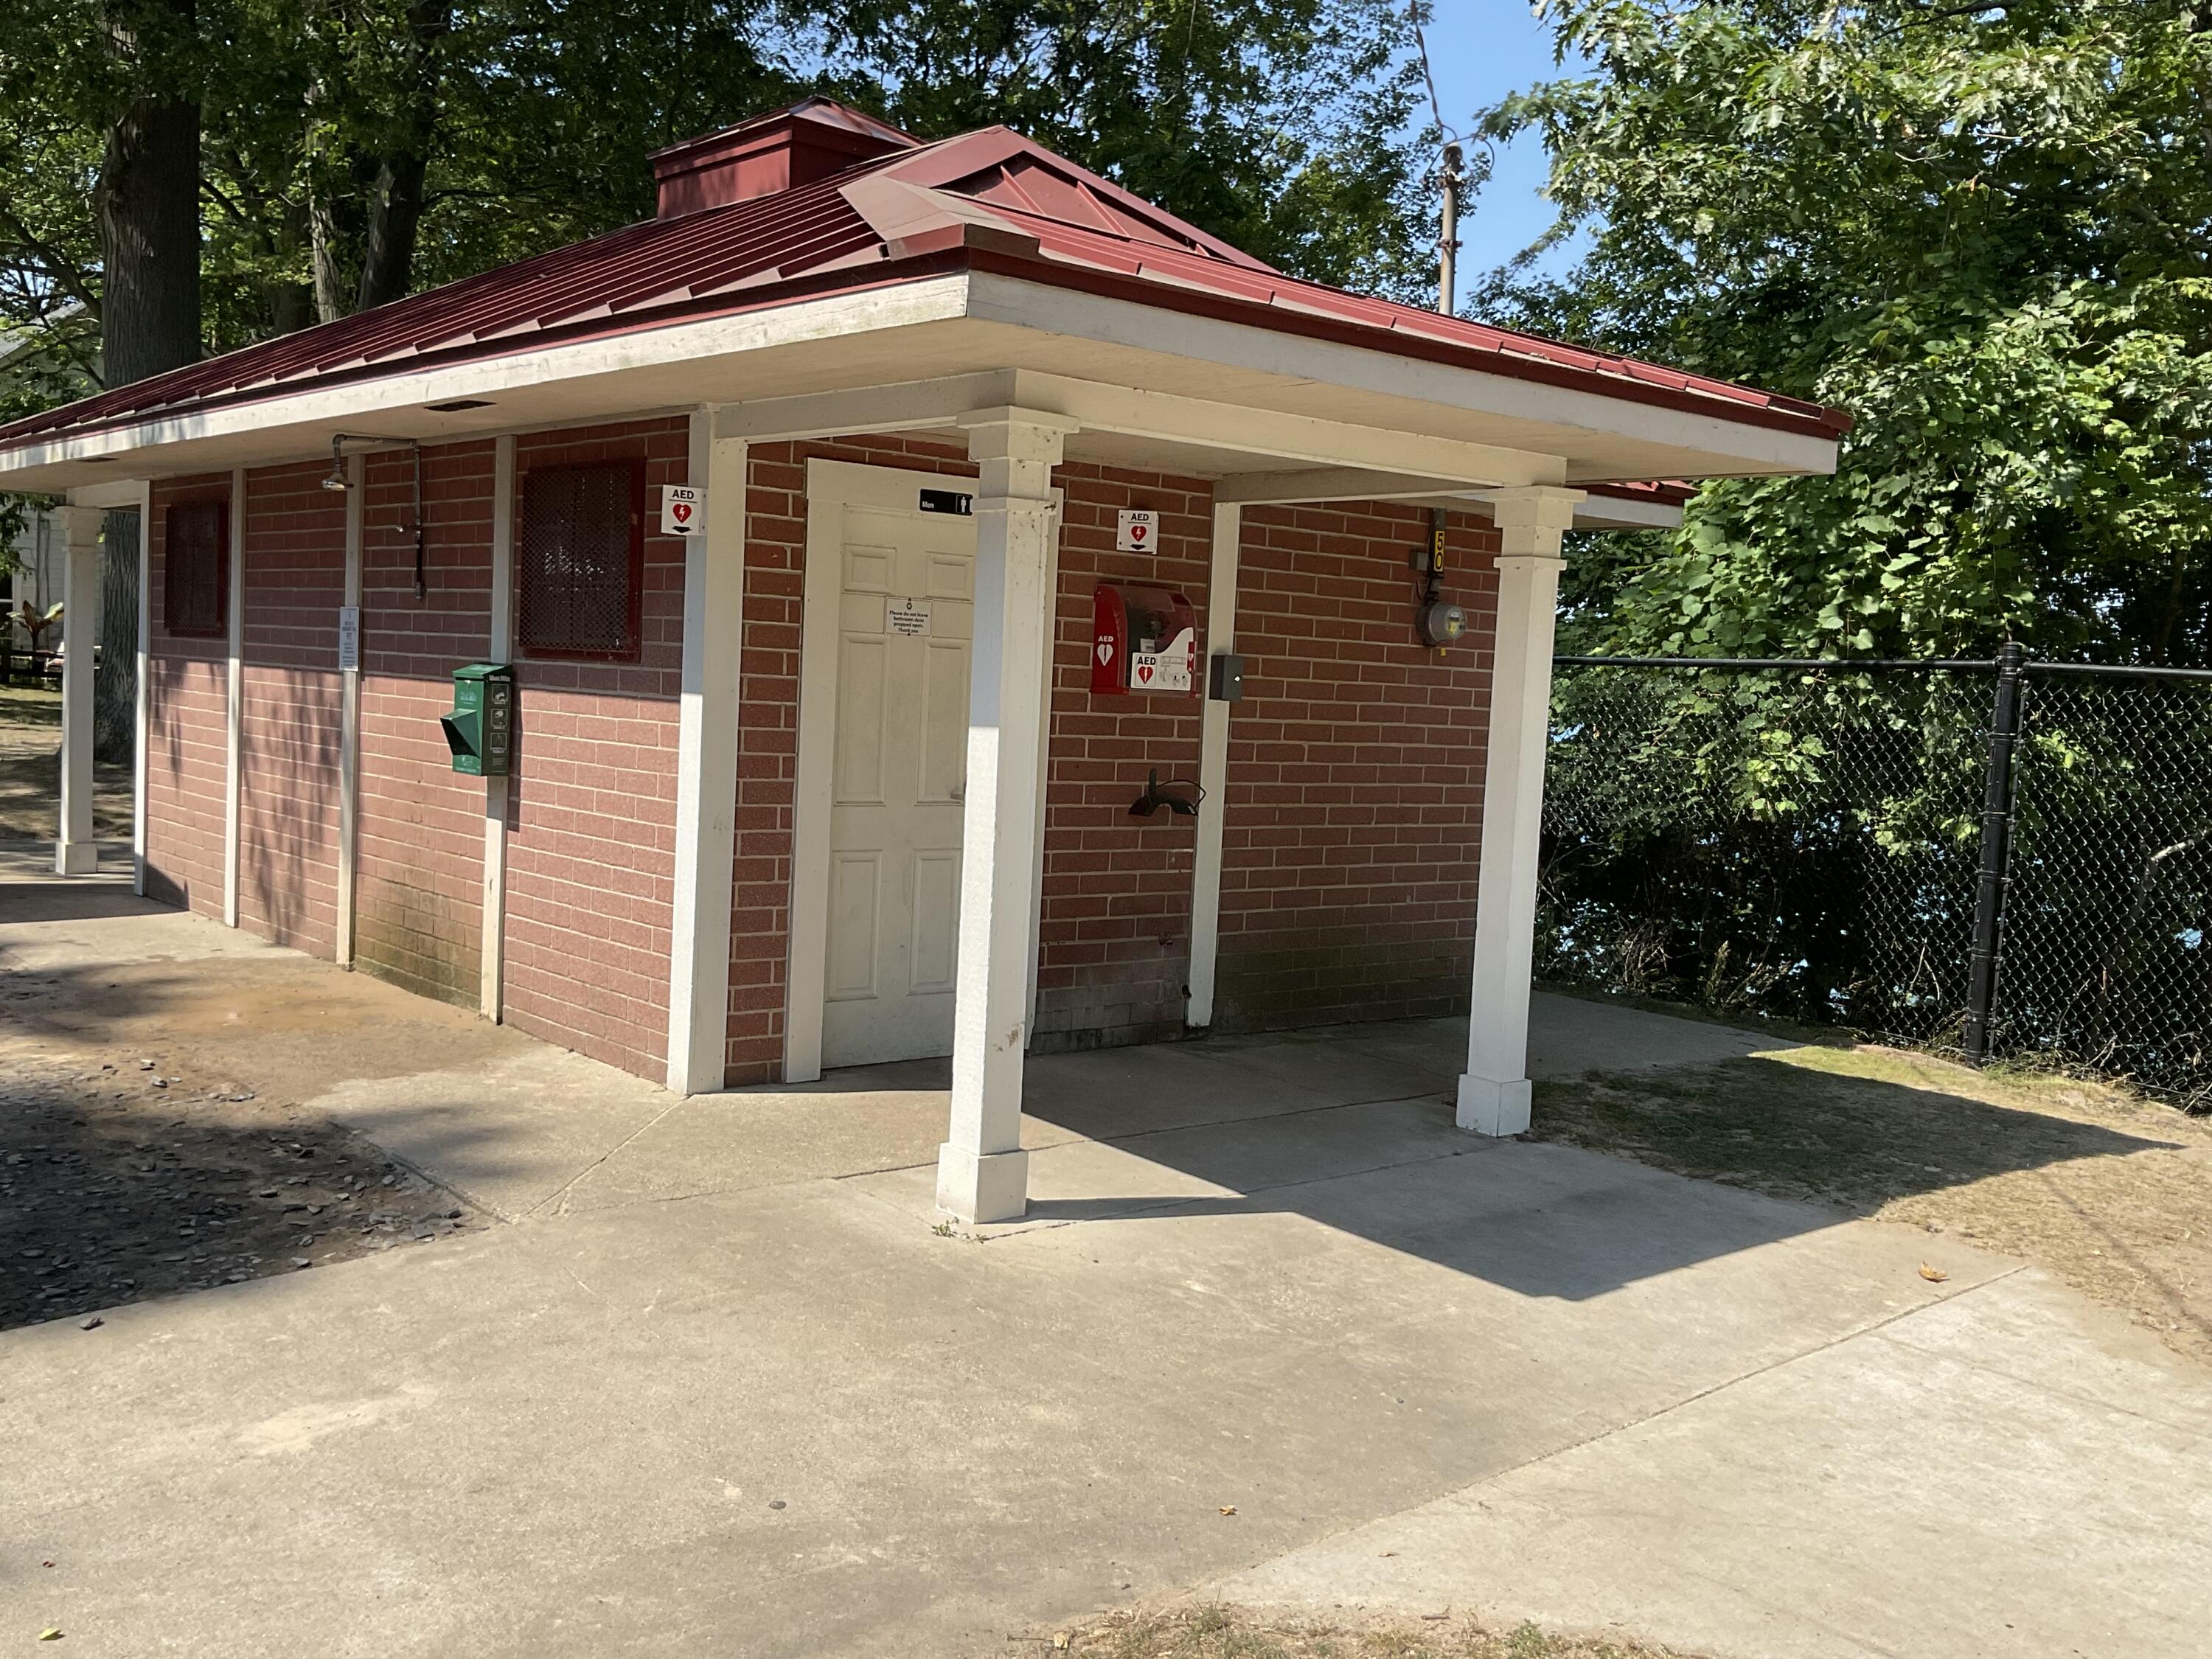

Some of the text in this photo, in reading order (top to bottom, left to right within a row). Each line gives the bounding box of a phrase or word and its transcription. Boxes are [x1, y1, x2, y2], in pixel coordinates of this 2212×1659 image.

[672, 490, 694, 499] AED
[1131, 513, 1149, 521] AED
[1137, 656, 1156, 665] AED
